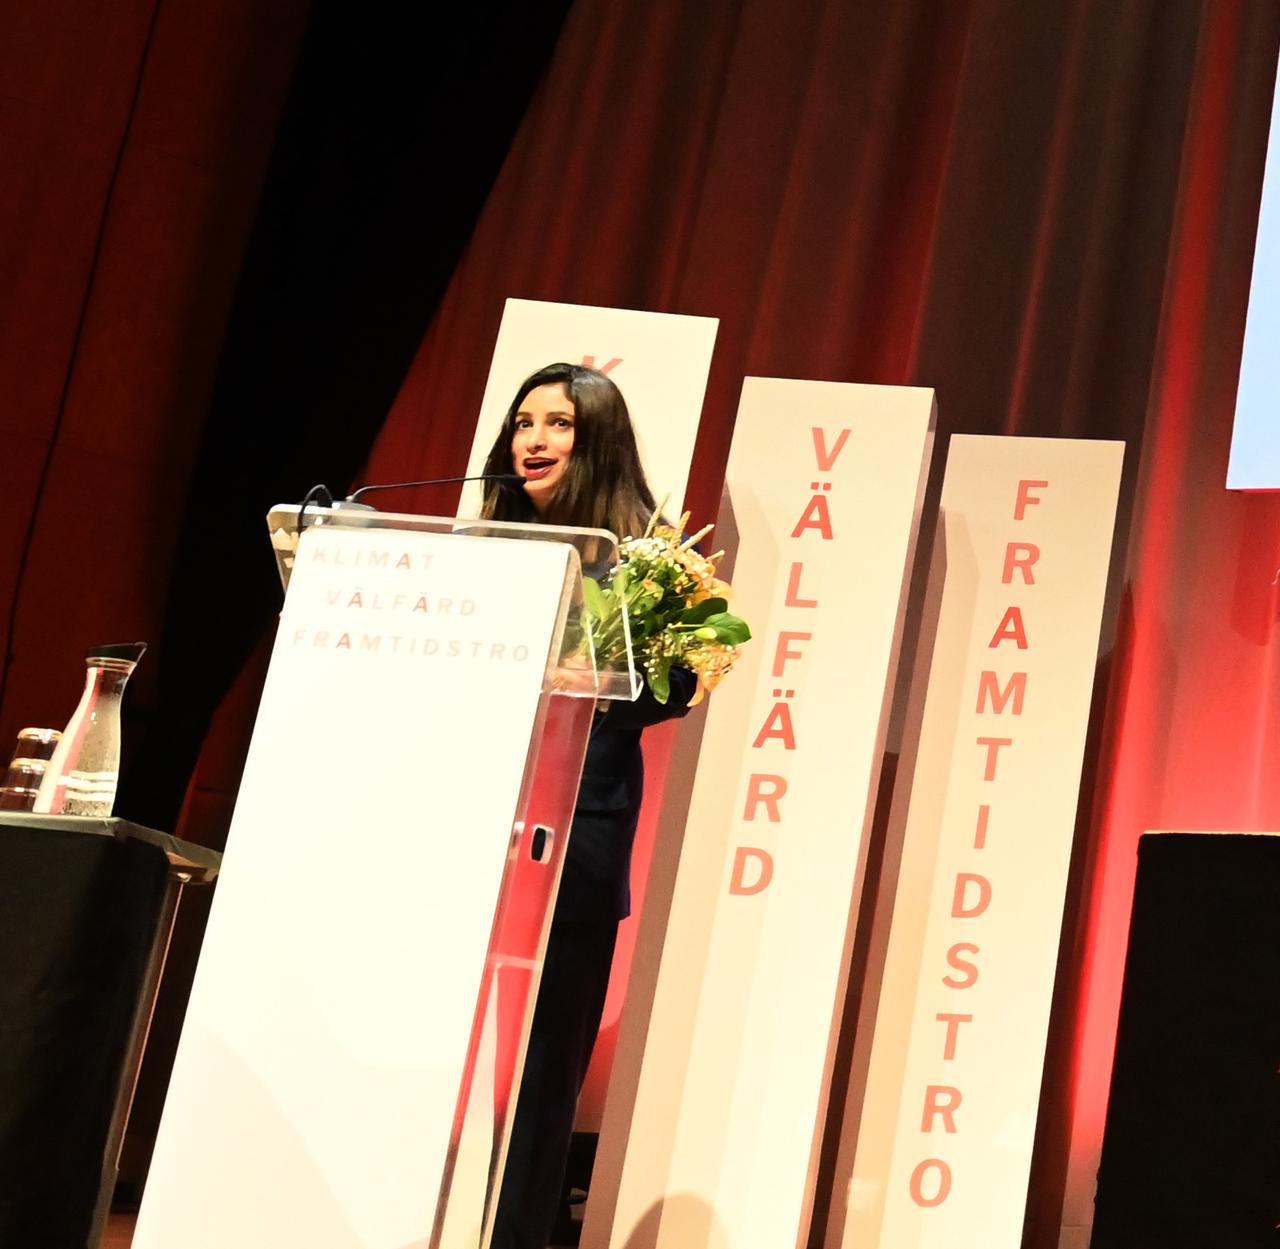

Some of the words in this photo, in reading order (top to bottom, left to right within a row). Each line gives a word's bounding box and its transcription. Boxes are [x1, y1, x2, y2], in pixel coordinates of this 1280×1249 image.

[312, 548, 435, 571] KLIMAT
[327, 587, 475, 616] VÄLFÄRD
[293, 629, 530, 662] FRAMTIDSTRO
[732, 427, 850, 896] VÄLFÄRD
[909, 480, 1048, 1207] FRAMTIDSTRO
